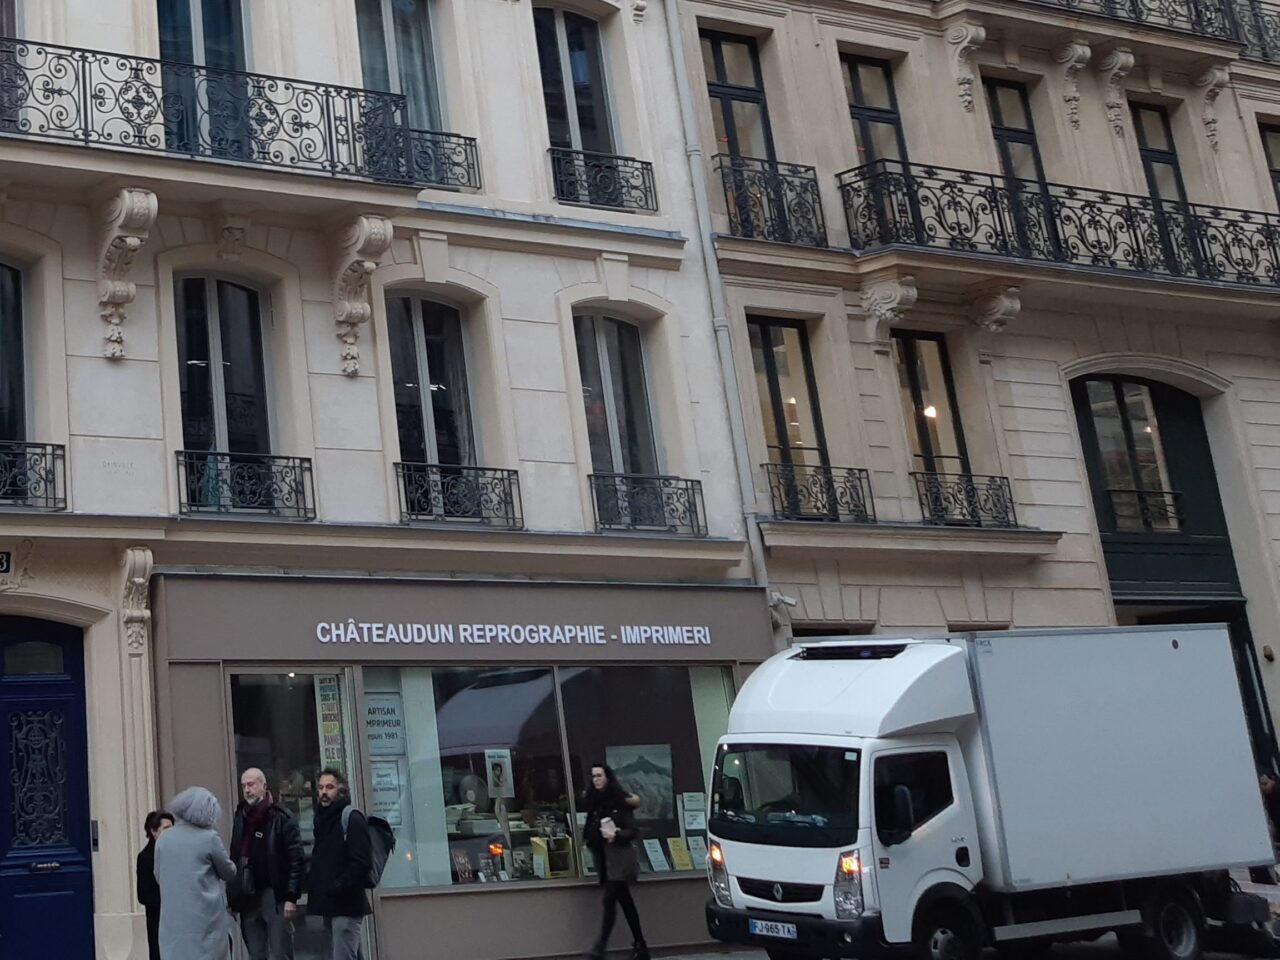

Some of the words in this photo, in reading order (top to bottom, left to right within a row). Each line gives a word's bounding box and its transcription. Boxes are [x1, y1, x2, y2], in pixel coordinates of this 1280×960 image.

[316, 618, 454, 644] CHÂTEAUDUN
[458, 624, 606, 644] REPROGRAPHIE
[620, 625, 711, 645] IMPRIMERI
[367, 706, 395, 715] ARTISAN
[366, 719, 401, 728] MPRIMEUR
